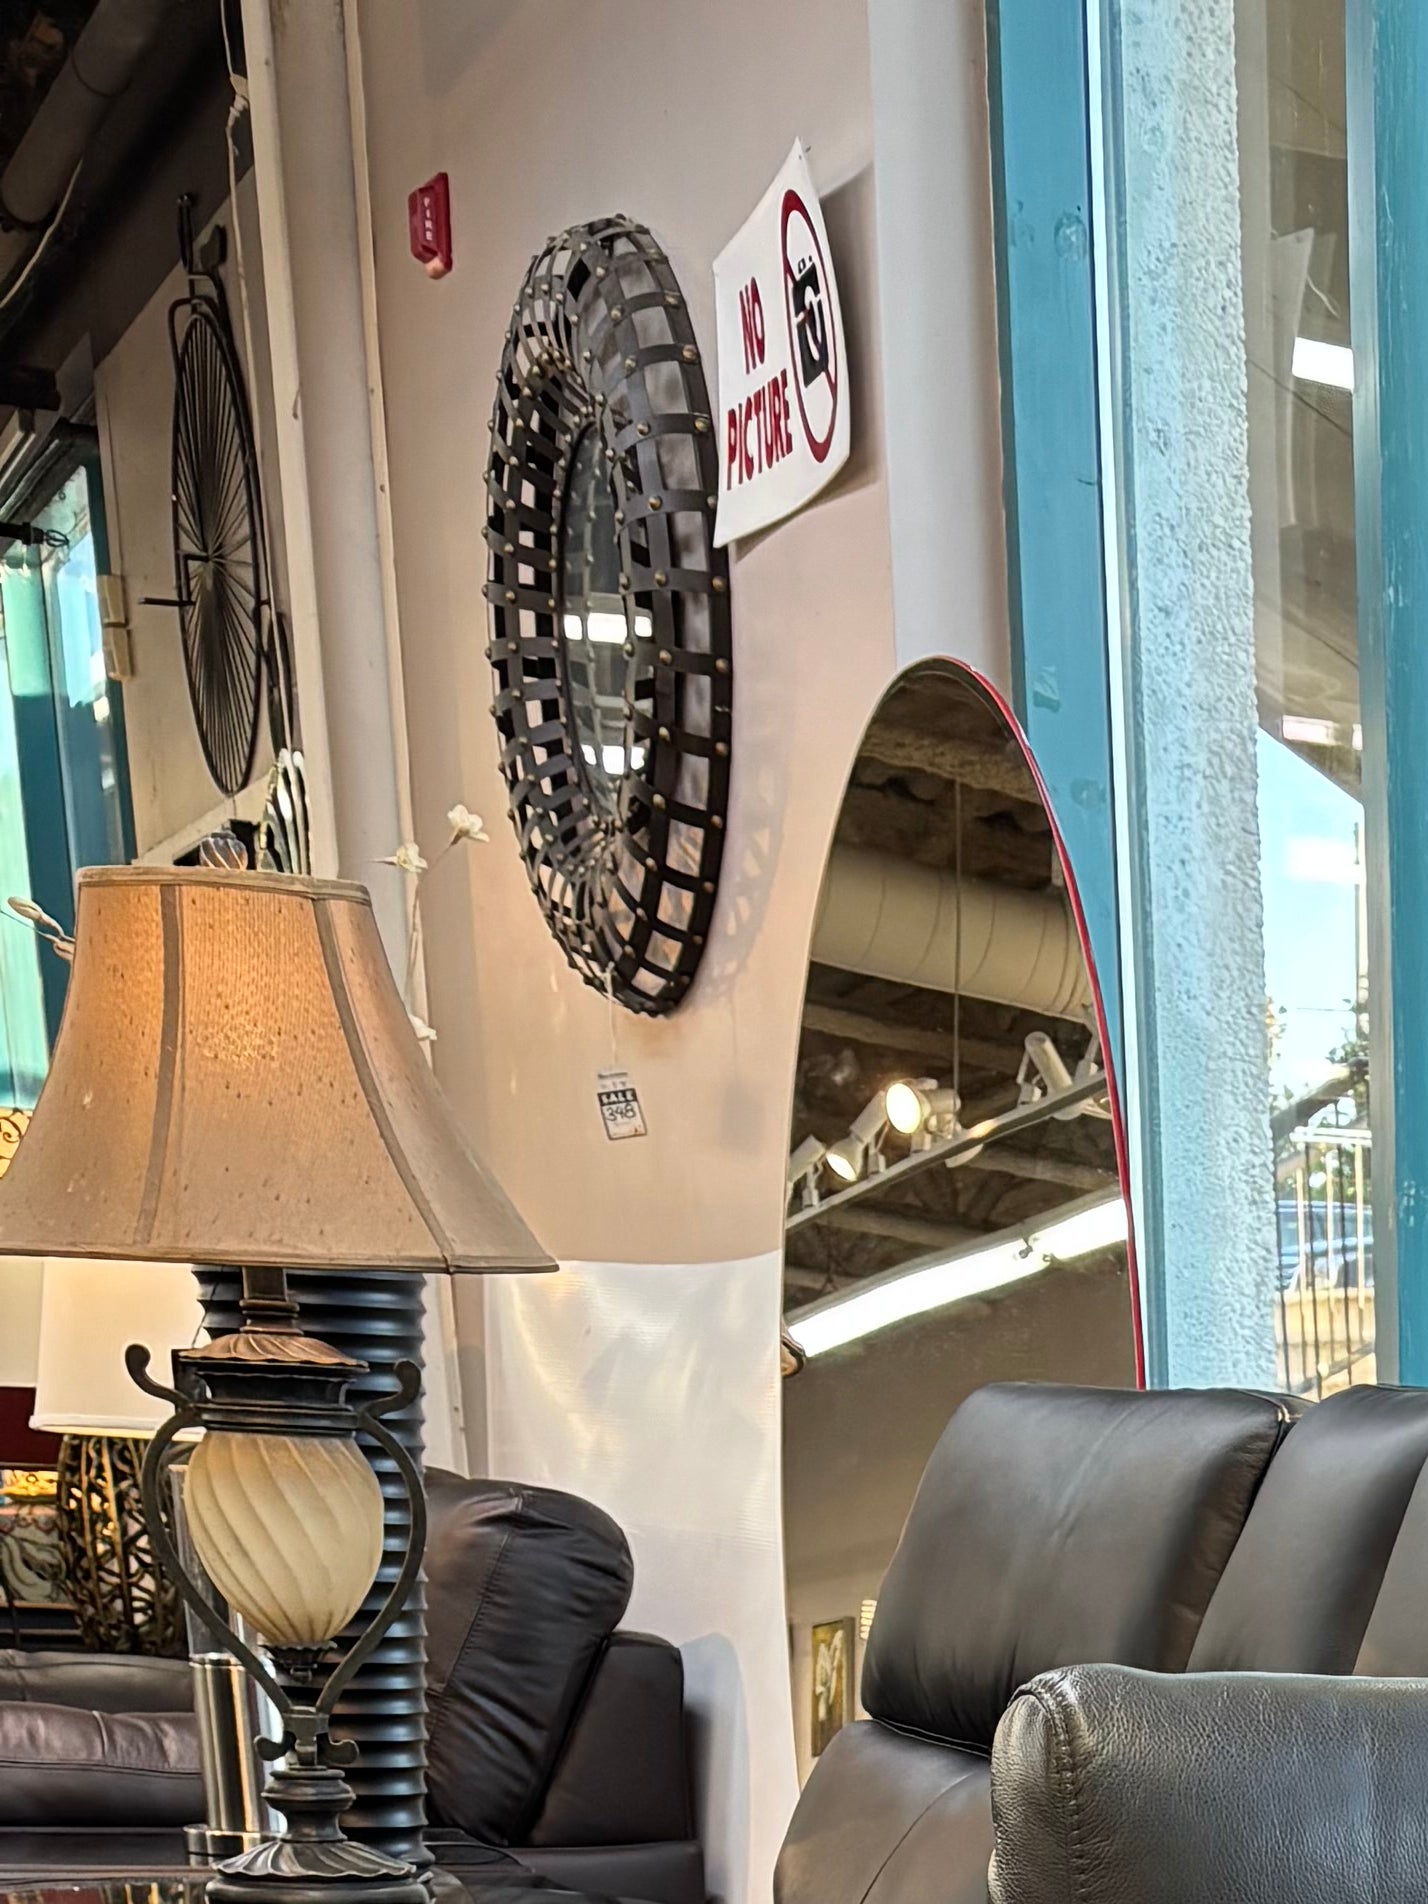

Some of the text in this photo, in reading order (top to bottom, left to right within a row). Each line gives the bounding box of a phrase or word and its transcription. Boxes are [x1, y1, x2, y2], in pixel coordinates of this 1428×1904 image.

[423, 196, 433, 241] FIRE
[739, 276, 765, 375] NO
[727, 368, 793, 491] PICTURE
[600, 1090, 635, 1105] SALE
